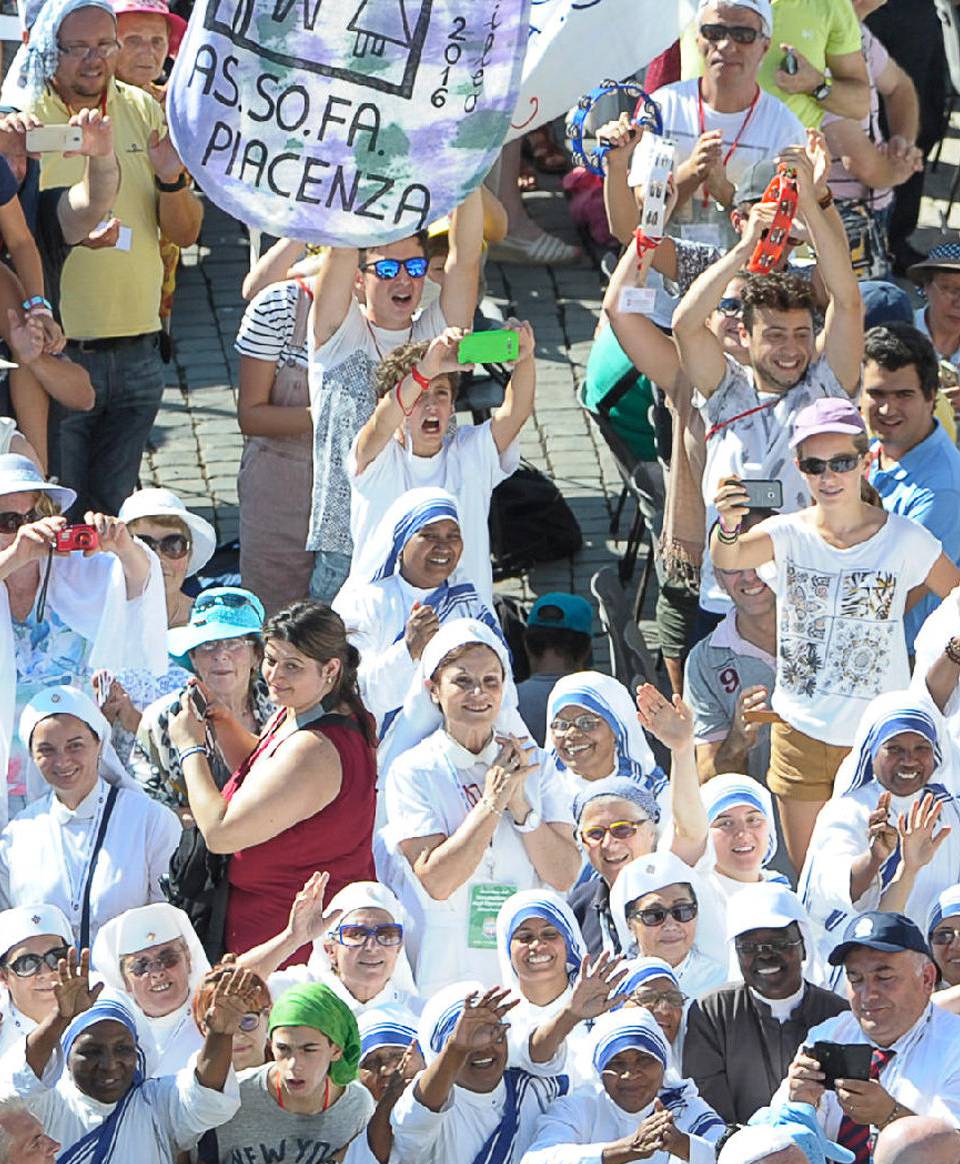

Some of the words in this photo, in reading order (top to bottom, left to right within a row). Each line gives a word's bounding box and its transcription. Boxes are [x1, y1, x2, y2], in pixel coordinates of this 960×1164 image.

[431, 16, 466, 108] 2016
[201, 120, 431, 231] PIACENZA
[720, 668, 740, 694] 9
